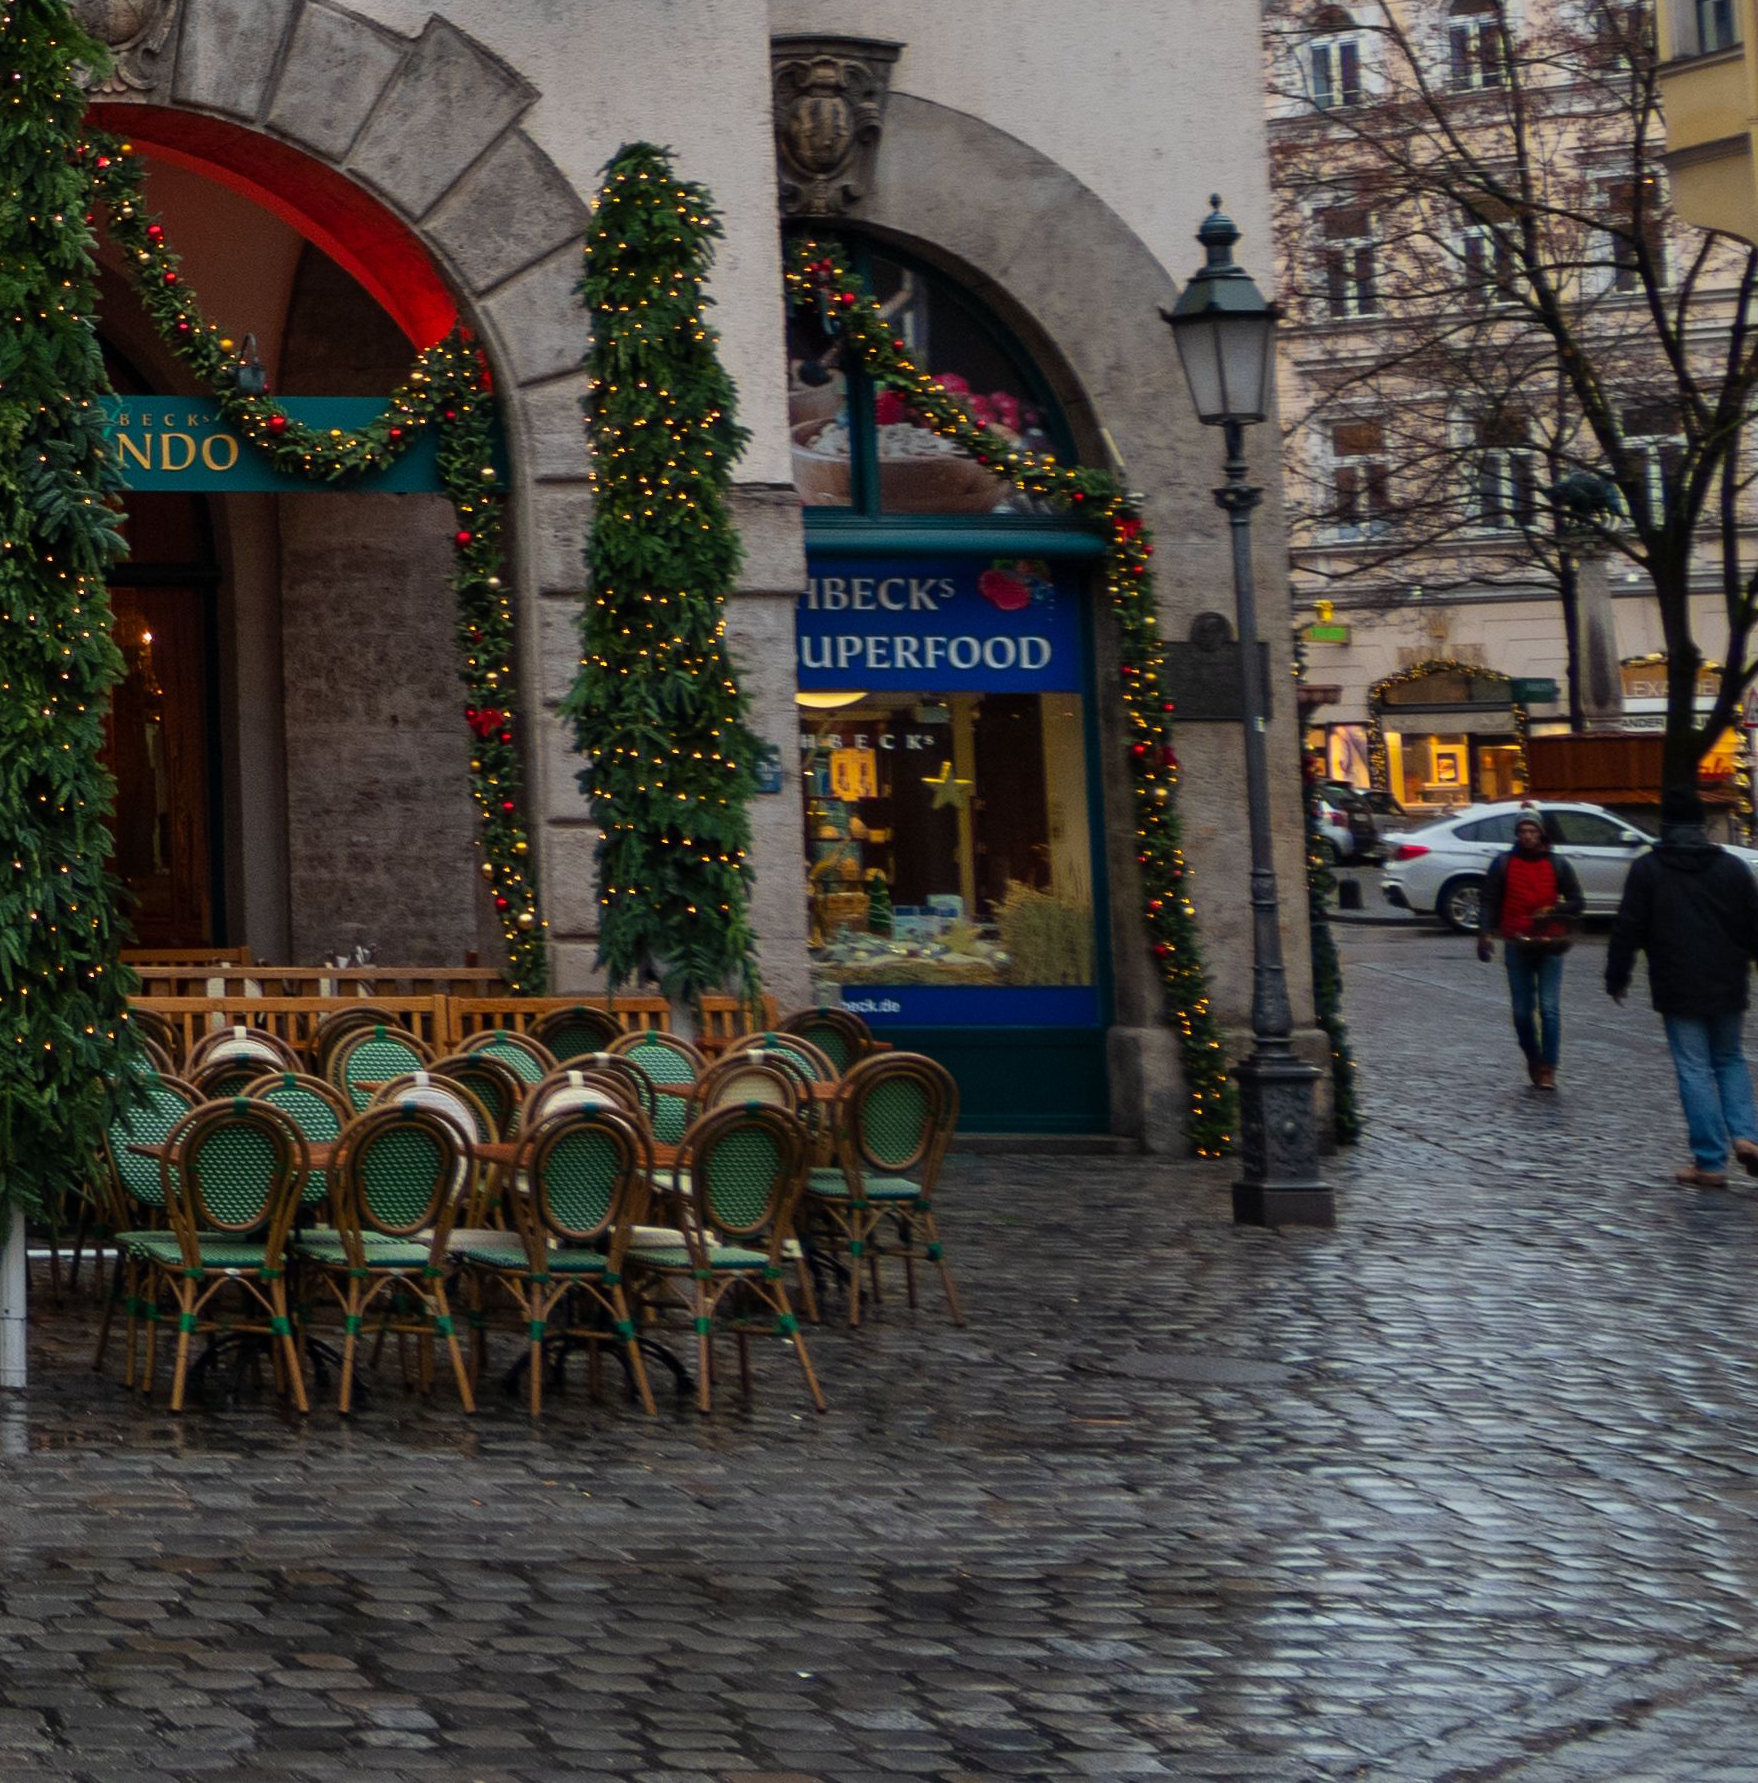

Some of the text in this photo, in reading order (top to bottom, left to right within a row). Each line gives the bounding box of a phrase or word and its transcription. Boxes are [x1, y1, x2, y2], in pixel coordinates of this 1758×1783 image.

[119, 414, 210, 426] BECKs
[116, 432, 239, 471] NDO
[796, 578, 955, 611] HBECKs
[800, 635, 1052, 669] UPERFOOD
[800, 734, 934, 750] HBECKs
